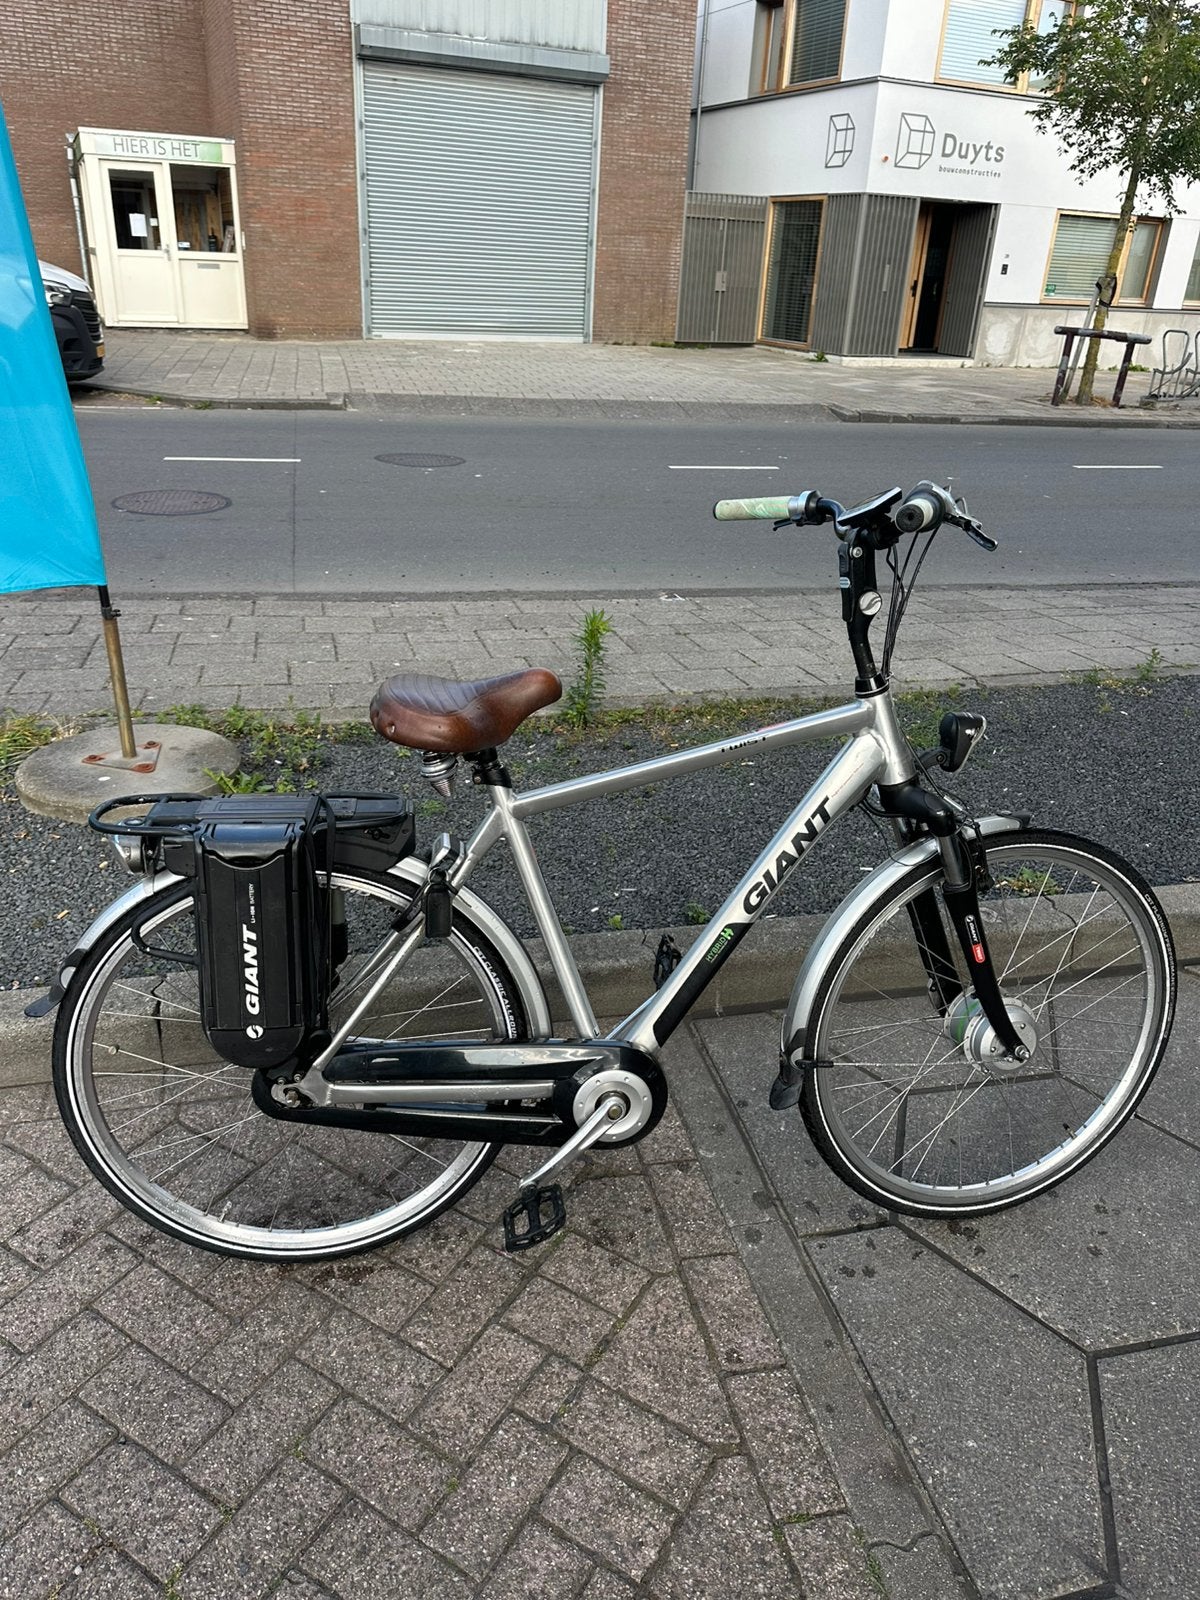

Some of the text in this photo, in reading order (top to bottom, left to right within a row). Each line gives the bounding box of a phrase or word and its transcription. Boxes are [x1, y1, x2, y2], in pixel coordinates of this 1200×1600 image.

[113, 137, 200, 158] HIER IS HET
[941, 132, 1005, 165] Duyts
[938, 165, 1002, 178] bouwconstructies
[743, 796, 831, 915] GIANT
[705, 936, 727, 962] HYBRID
[242, 923, 260, 1016] GIANT
